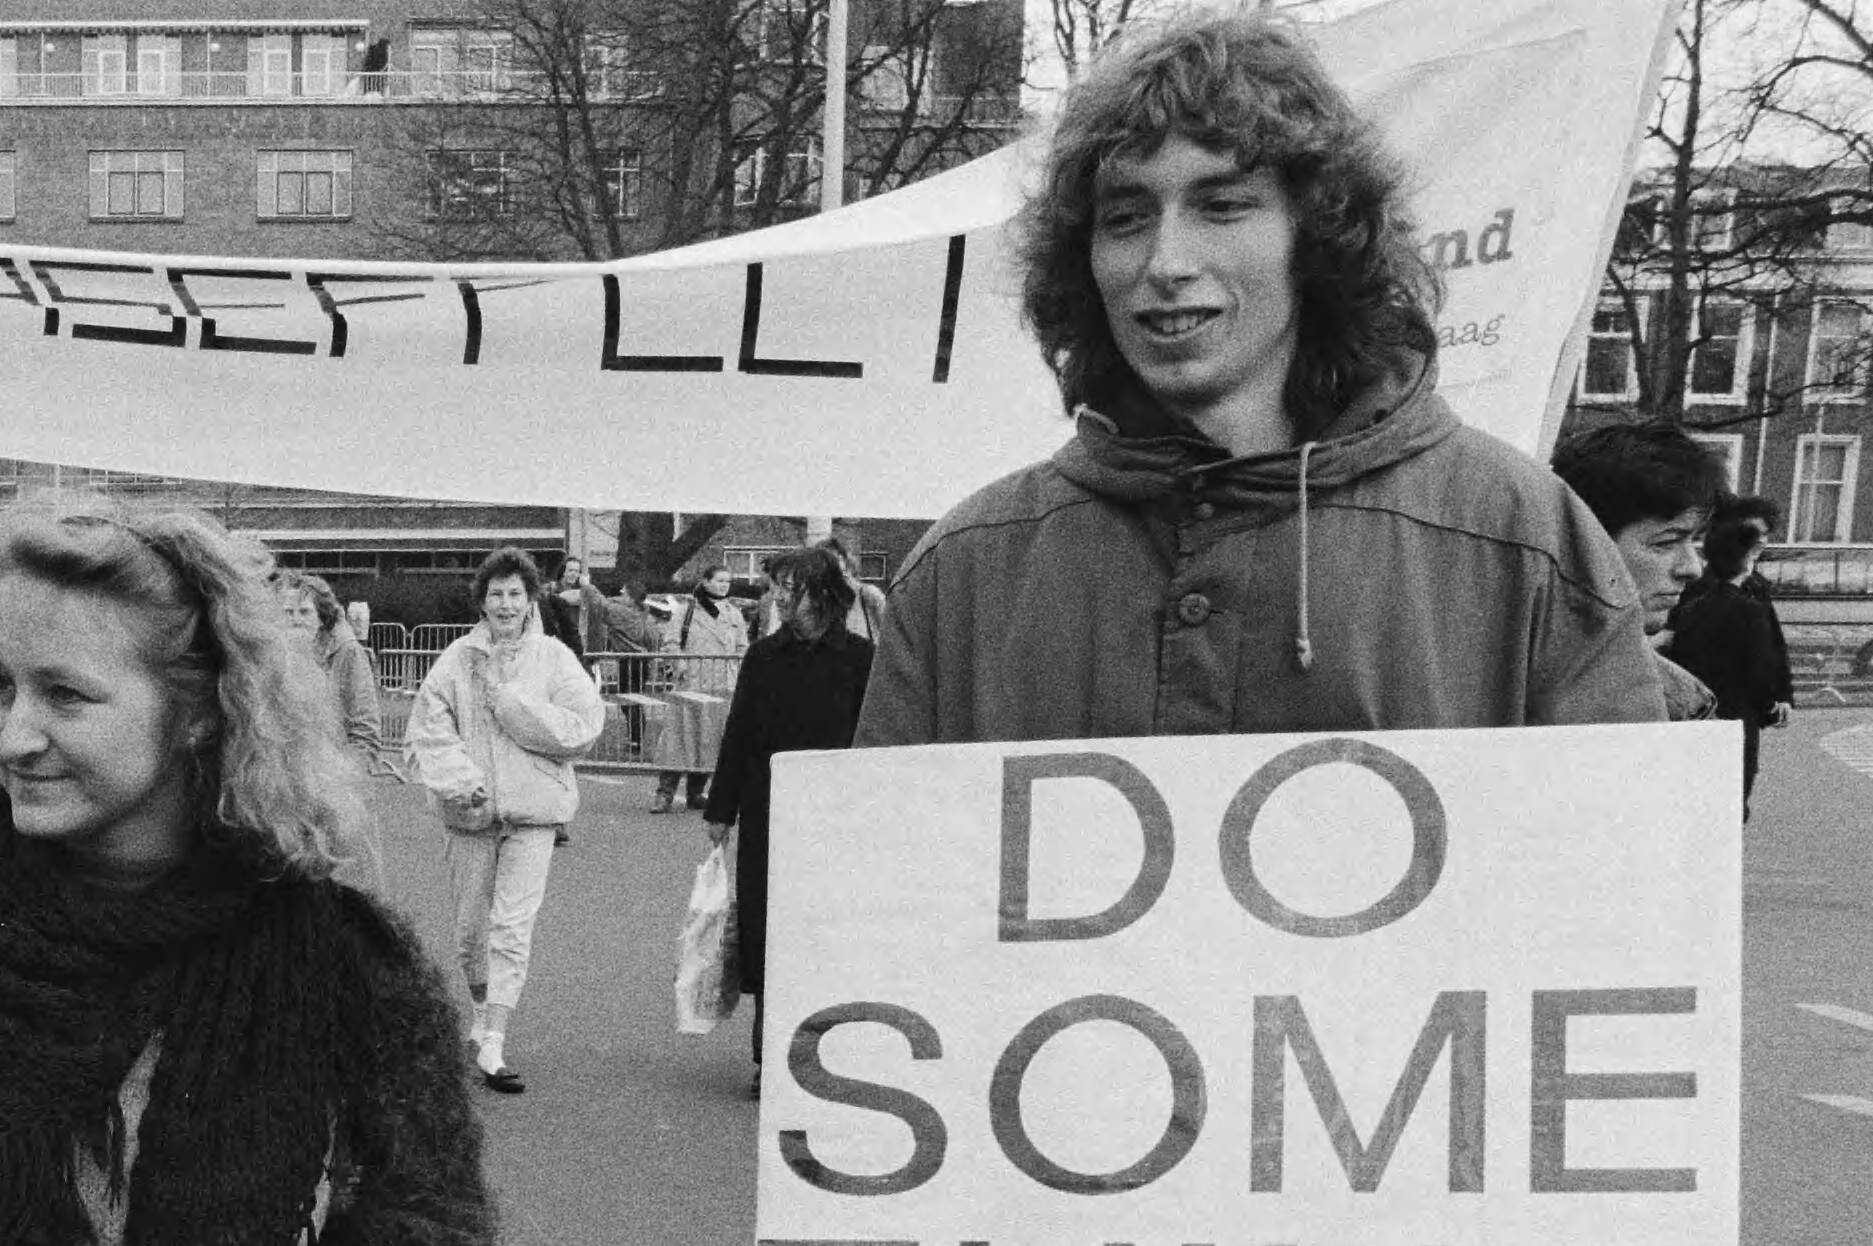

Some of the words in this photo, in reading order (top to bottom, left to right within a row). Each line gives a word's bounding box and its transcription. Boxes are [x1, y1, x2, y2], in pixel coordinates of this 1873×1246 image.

[1437, 312, 1506, 348] aag
[997, 737, 1448, 943] DO
[778, 986, 1699, 1197] SOME
